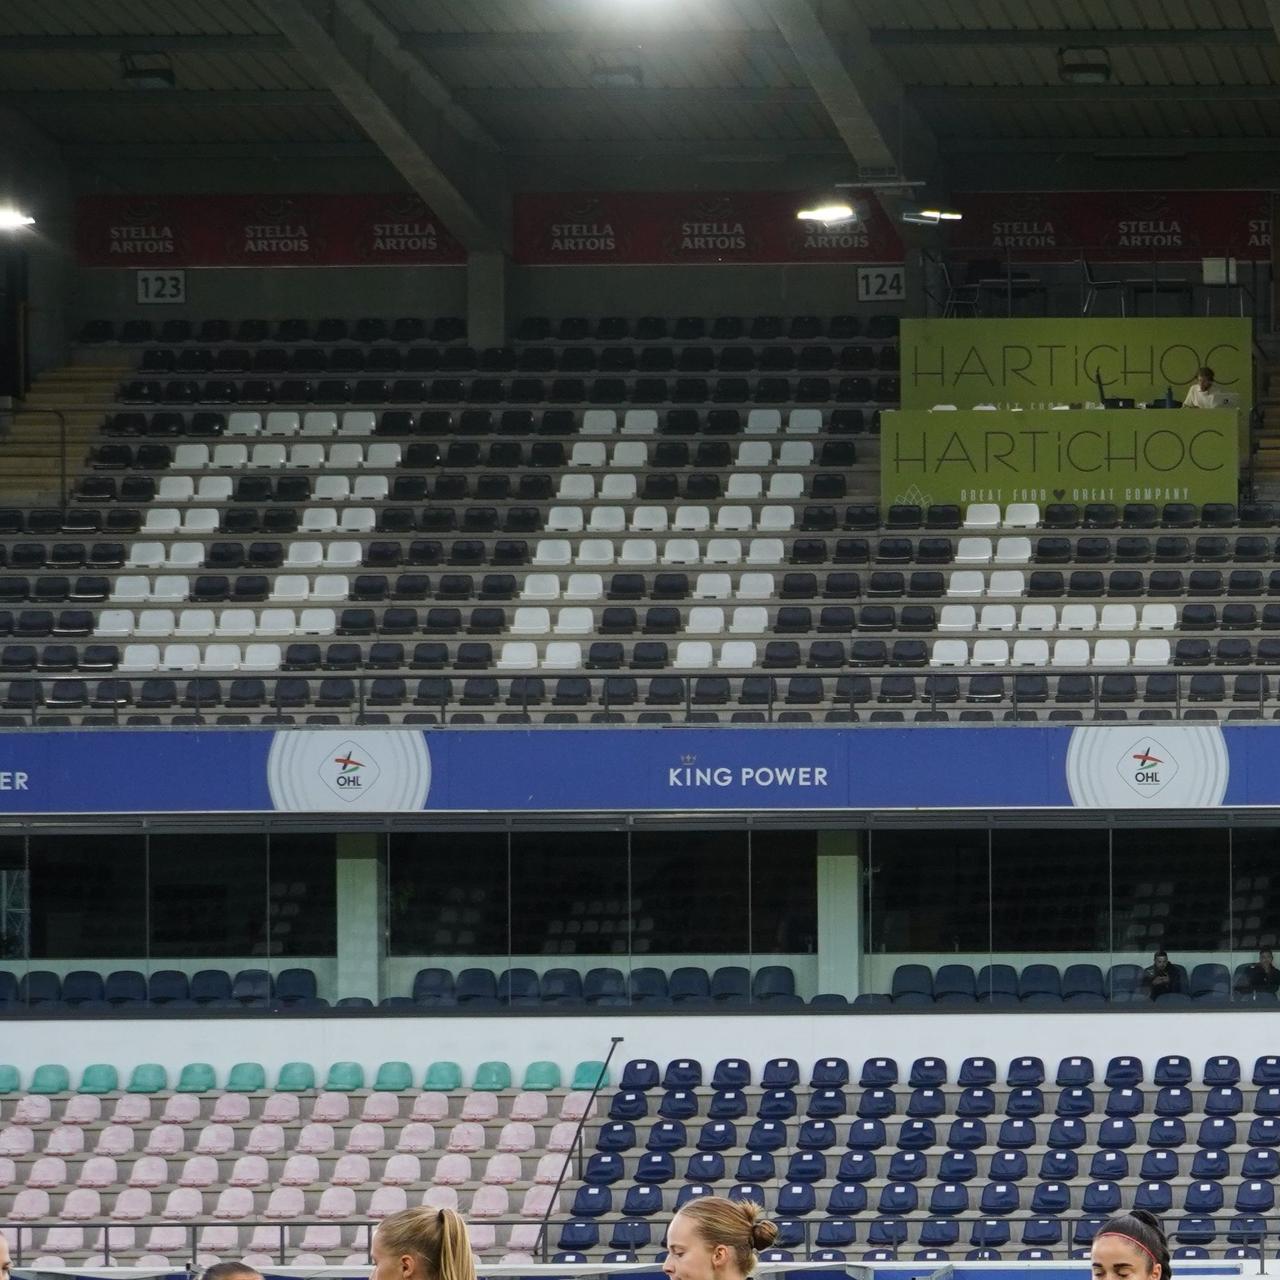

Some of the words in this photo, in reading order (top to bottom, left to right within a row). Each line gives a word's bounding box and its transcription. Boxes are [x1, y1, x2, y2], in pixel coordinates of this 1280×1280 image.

[110, 226, 173, 239] STELLA
[245, 225, 308, 239] STELLA
[374, 224, 436, 237] STELLA
[552, 224, 615, 237] STELLA
[682, 223, 745, 236] STELLA
[992, 222, 1055, 235] STELLA
[1119, 221, 1181, 234] STELLA
[110, 239, 174, 253] ARTOIS
[244, 238, 309, 252] ARTOIS
[374, 237, 437, 251] ARTOIS
[552, 237, 615, 250] ARTOIS
[681, 236, 745, 249] ARTOIS
[804, 235, 869, 248] ARTOIS
[992, 235, 1056, 247] ARTOIS
[1118, 234, 1182, 247] ARTOIS
[140, 276, 181, 298] 123
[861, 273, 903, 296] 124
[961, 489, 1001, 501] GREAT
[1013, 489, 1047, 501] FOOD
[1073, 488, 1114, 501] GREAT
[1125, 487, 1189, 500] COMPANY
[336, 775, 362, 787] OHL
[669, 768, 733, 786] KING
[741, 768, 828, 786] POWER
[1134, 771, 1161, 783] OHL
